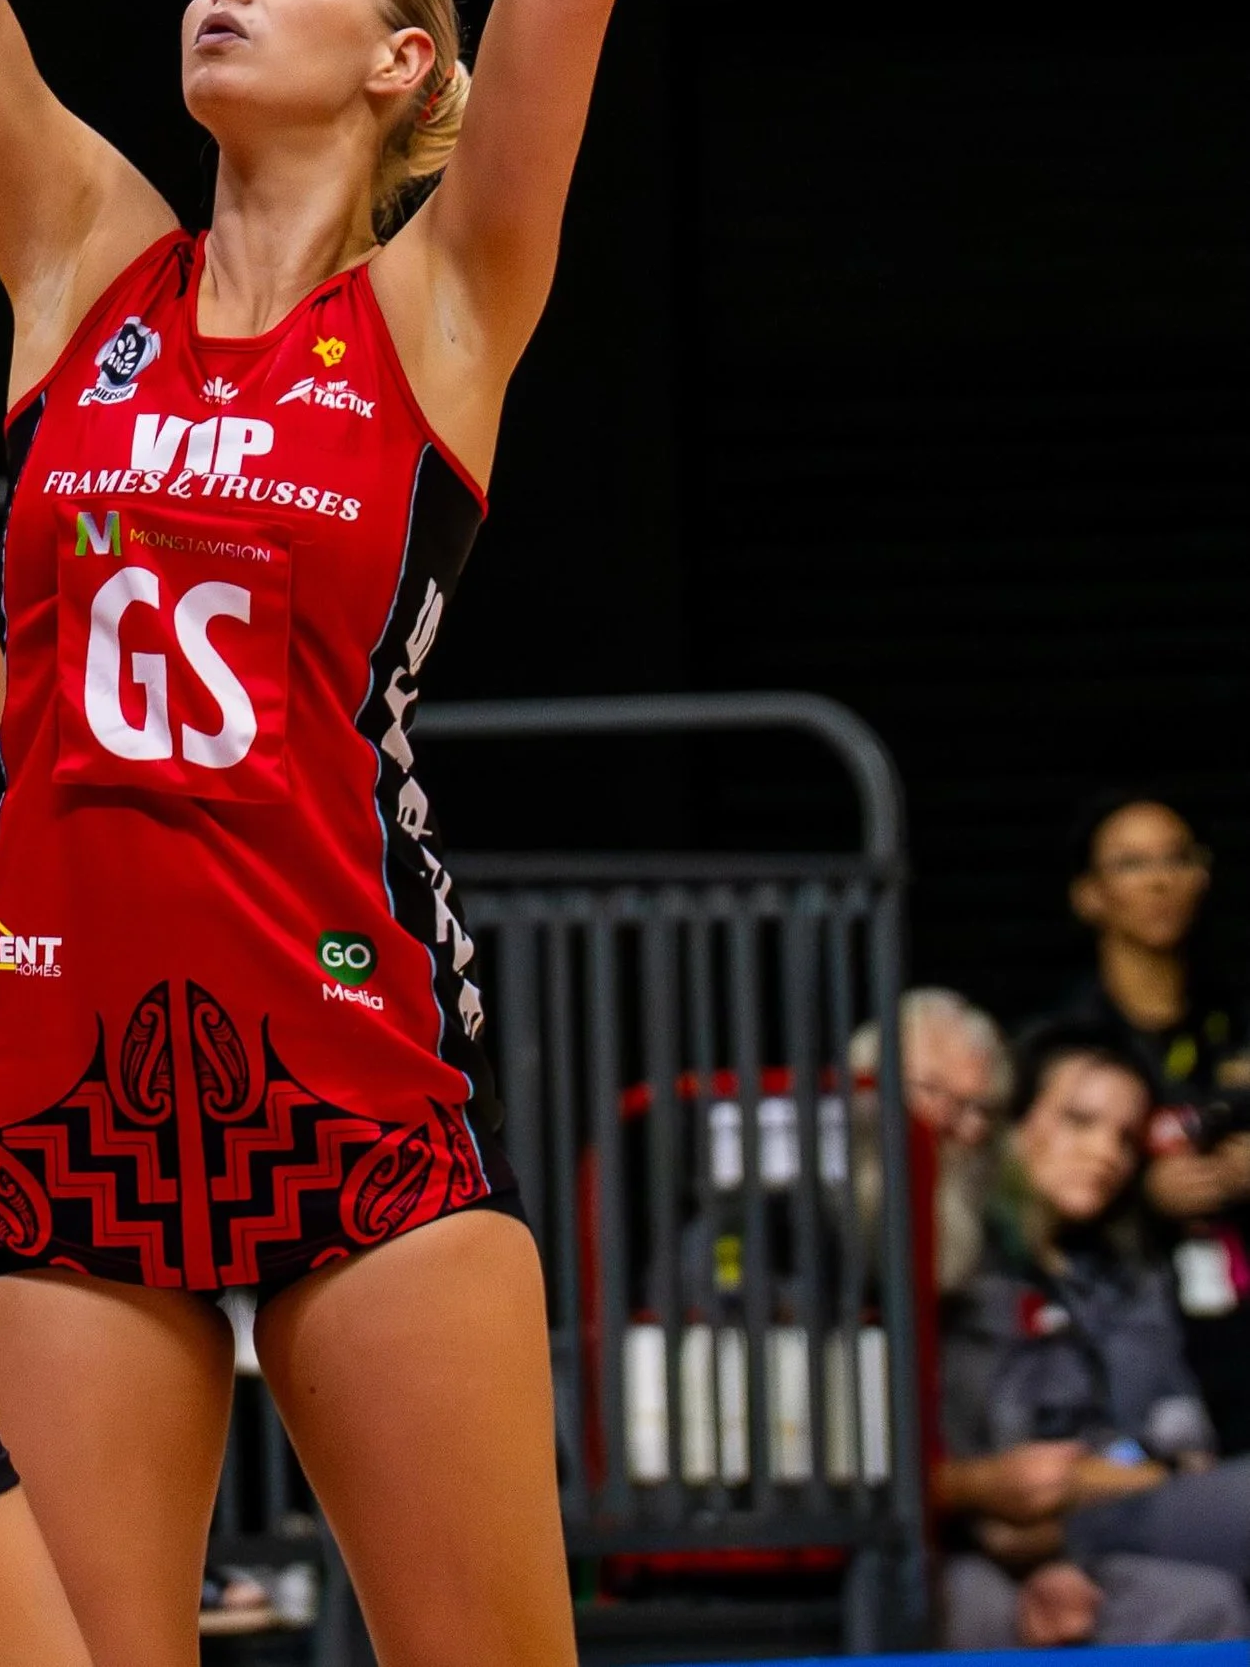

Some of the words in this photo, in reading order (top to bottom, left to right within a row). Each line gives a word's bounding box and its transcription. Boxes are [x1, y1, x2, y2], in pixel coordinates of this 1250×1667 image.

[313, 387, 376, 419] TACTIX
[130, 413, 275, 476] VIP
[43, 469, 166, 496] FRAMES
[166, 469, 195, 499] &
[199, 472, 363, 522] TRUSSES
[129, 527, 271, 563] MONSTAVISION
[83, 565, 258, 770] GS
[15, 963, 62, 977] HOMES
[322, 941, 371, 969] GO
[322, 982, 384, 1011] Media
